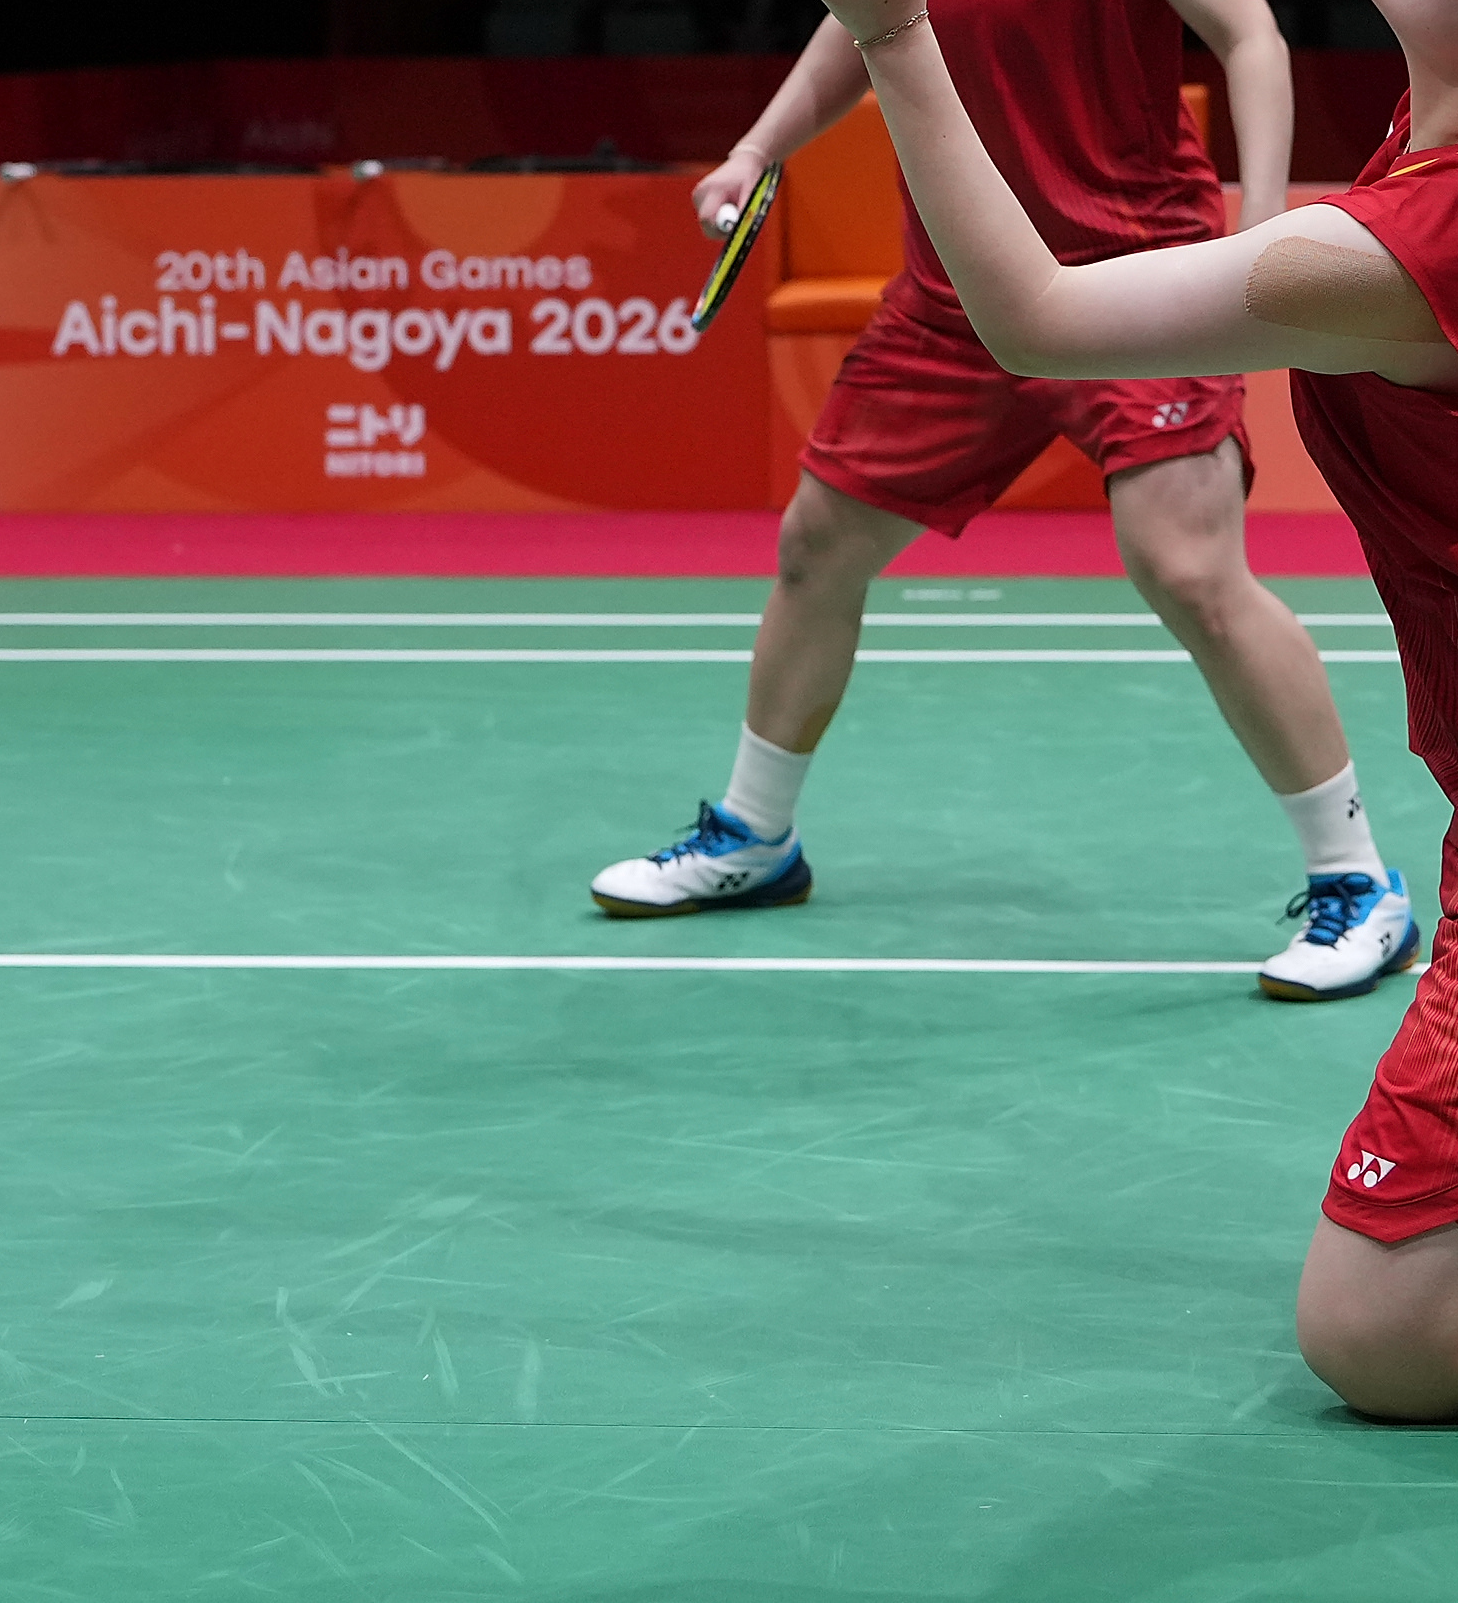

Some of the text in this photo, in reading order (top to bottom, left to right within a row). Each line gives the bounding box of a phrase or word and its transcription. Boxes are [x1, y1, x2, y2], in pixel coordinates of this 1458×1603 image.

[154, 246, 593, 291] 20th Asian Games
[51, 294, 702, 371] Aichi-Nagoya 2026
[325, 403, 427, 447] ニトリ
